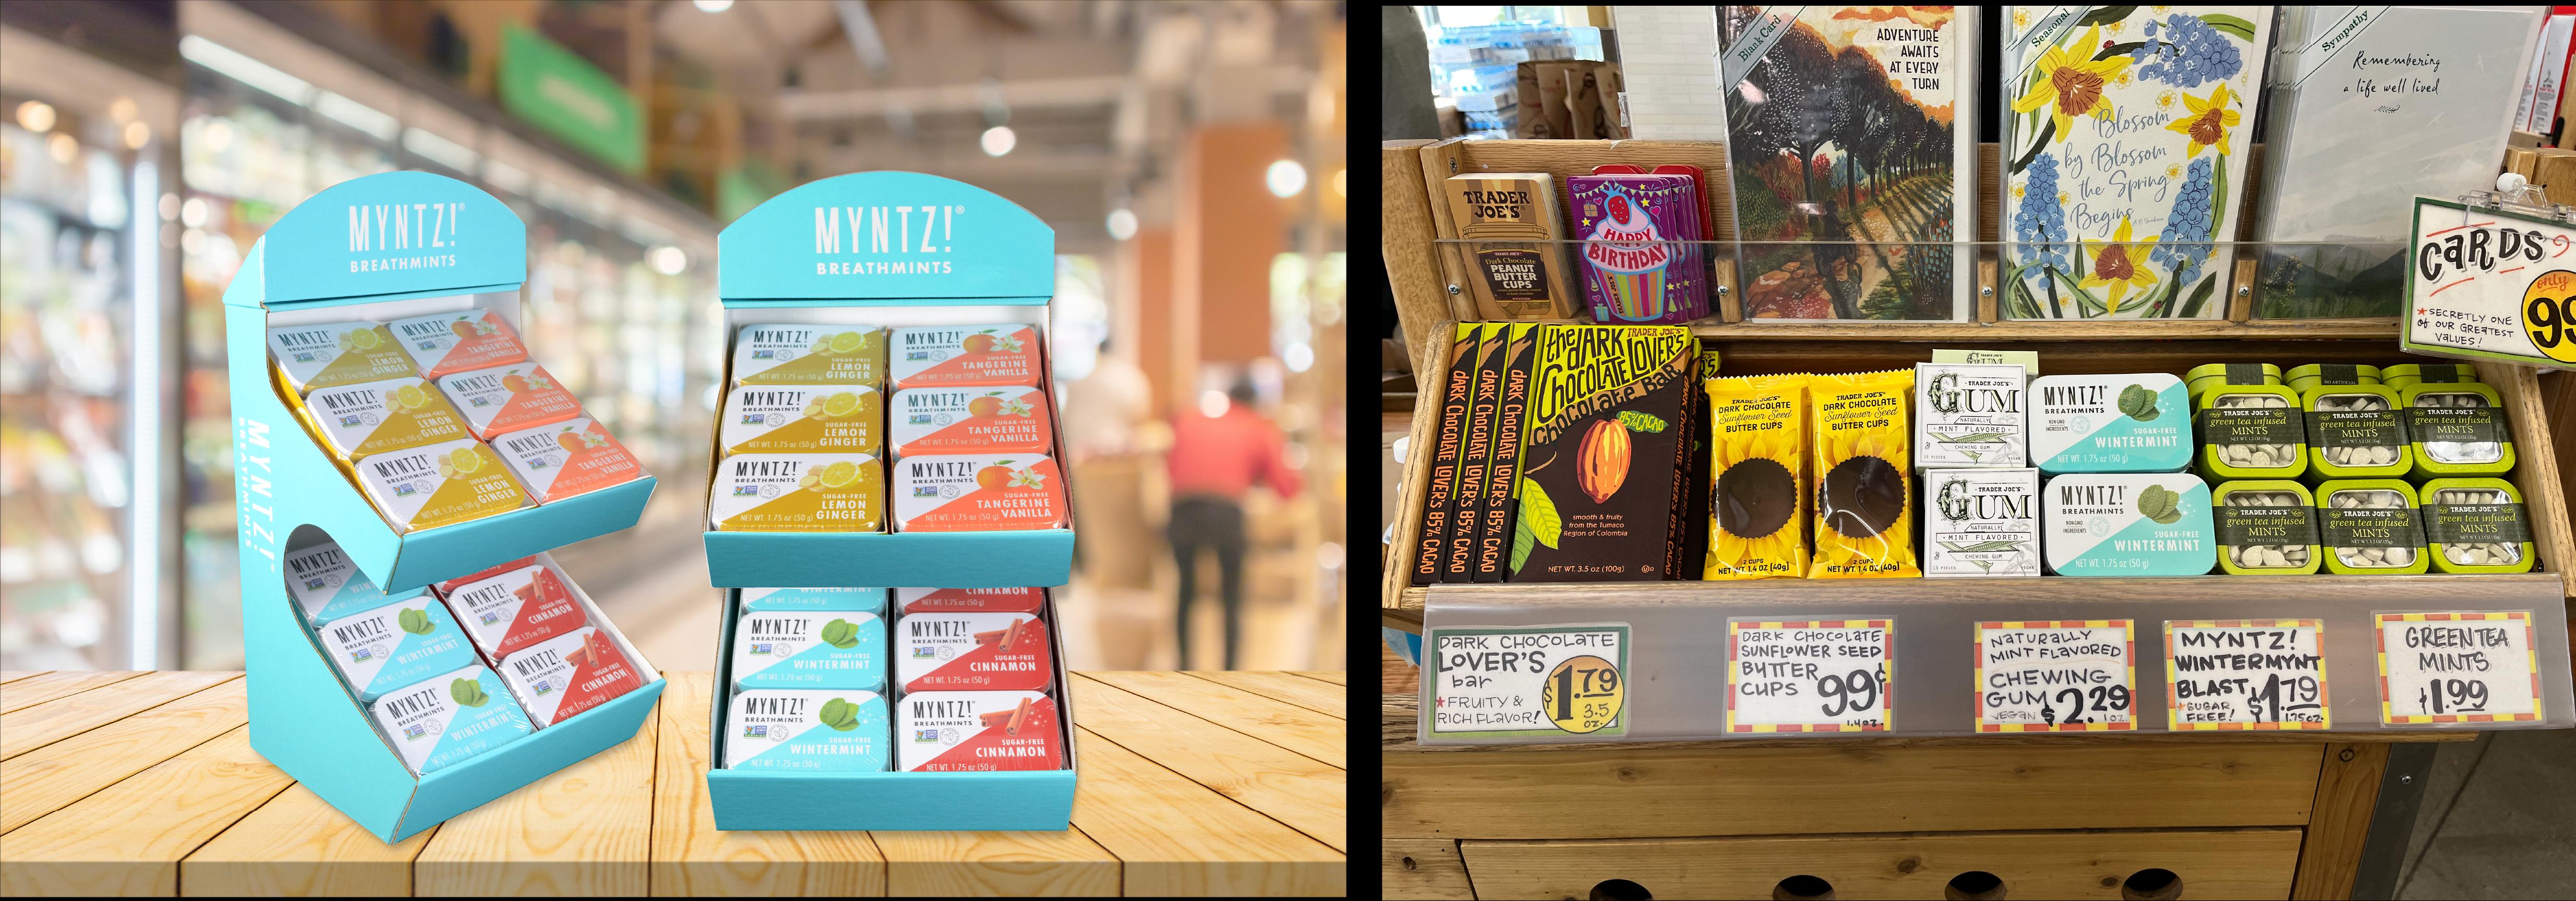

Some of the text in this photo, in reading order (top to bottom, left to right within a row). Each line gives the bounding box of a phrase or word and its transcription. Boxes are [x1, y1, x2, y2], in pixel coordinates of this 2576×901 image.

[1877, 28, 1939, 42] ADVENTURE
[2031, 8, 2070, 47] Seasonal
[2322, 10, 2368, 52] Sympathy
[1738, 15, 1781, 63] Blank Card
[1901, 46, 1939, 58] AWAITS
[1890, 62, 1939, 74] AT EVERY
[2353, 51, 2440, 73] Remembering
[1912, 78, 1939, 90] TURN
[2356, 79, 2376, 98] life
[2384, 79, 2405, 93] well
[2412, 78, 2438, 94] lived
[2093, 106, 2169, 137] Blossom
[2065, 141, 2166, 178] by Blossom
[2079, 170, 2170, 202] the Spring
[1463, 191, 1531, 205] TRADER
[1474, 206, 1520, 218] JOE'S
[2071, 203, 2134, 237] Begins
[350, 203, 457, 252] MYNTZ!
[815, 206, 952, 254] MYNTZ!
[1604, 228, 1652, 247] HAPPY
[351, 254, 456, 273] BREATHMINTS
[1588, 242, 1667, 269] BIRTHDAY
[817, 261, 952, 275] BREATHMINTS
[2537, 274, 2569, 291] only
[2417, 319, 2430, 328] of
[2429, 308, 2512, 325] SECRETLY ONE
[1627, 328, 1657, 337] TRADER
[1547, 329, 1576, 361] the
[1928, 373, 2020, 414] GUM
[2044, 385, 2103, 406] MYNTZ!
[1849, 398, 1896, 408] CHOCOLATE
[1824, 406, 1898, 423] Sunflower Seed
[1832, 419, 1888, 431] BUTTER CUPS
[2096, 435, 2177, 448] WINTERMINT
[374, 454, 431, 477] MYNTZ!
[736, 461, 797, 476] MYNTZ!
[239, 417, 251, 548] BREATHMINTS
[387, 471, 436, 484] BREATHMINTS
[469, 474, 502, 485] SUGAR-FREE
[248, 419, 274, 561] MYNTZ!
[473, 480, 508, 494] LEMON
[478, 489, 517, 504] GINGER
[822, 501, 866, 509] LEMON
[977, 500, 1050, 508] TANGERINE
[816, 510, 865, 519] GINGER
[1001, 509, 1052, 518] VANILLA
[2226, 518, 2252, 528] green
[2271, 516, 2305, 527] infused
[2248, 528, 2286, 536] MINTS
[2182, 629, 2296, 650] MYNTZ!
[2405, 627, 2509, 649] GREEN TEA
[1741, 644, 1882, 658] SUNFLOWER SEED
[1990, 648, 2033, 663] MINT
[1438, 651, 1545, 673] LOVER'S
[2175, 654, 2320, 672] WINTERMYNT
[2419, 651, 2490, 672] MINTS
[1742, 662, 1819, 680] BUTTER
[1990, 668, 2111, 689] CHEWING
[1741, 682, 1798, 696] CUPS
[2177, 678, 2249, 699] BLAST
[746, 698, 804, 715] MYNTZ!
[1448, 696, 1523, 709] FRUITY &
[1986, 690, 2047, 708] GUM
[2187, 702, 2230, 711] SUGAR
[914, 701, 971, 719] MYNTZ!
[1438, 712, 1472, 724] RICH
[1584, 703, 1609, 719] 3.5
[2187, 709, 2235, 722] FREE!
[791, 745, 871, 754] WINTERMINT
[976, 747, 1045, 757] CINNAMON
